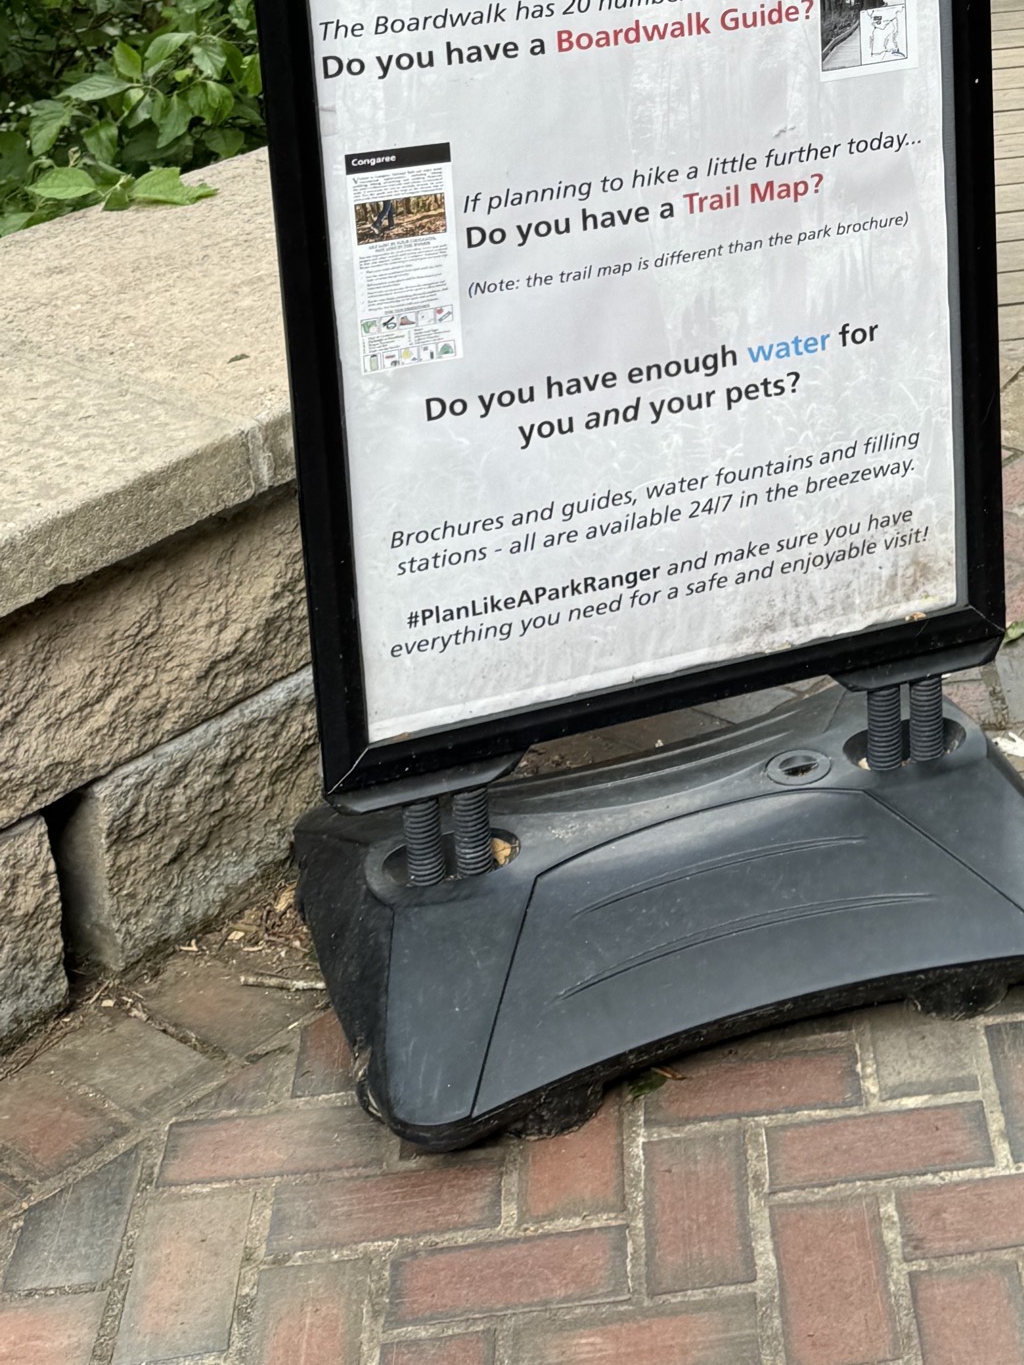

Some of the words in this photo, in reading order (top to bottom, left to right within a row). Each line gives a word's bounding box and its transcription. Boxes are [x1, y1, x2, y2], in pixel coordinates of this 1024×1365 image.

[319, 19, 364, 41] The
[374, 3, 506, 35] Boardwalk
[516, 1, 555, 20] has
[323, 56, 365, 79] Do
[376, 51, 434, 79] you
[446, 41, 519, 65] have
[530, 39, 545, 56] a
[557, 12, 711, 52] Boardwalk
[351, 155, 396, 166] Congaree
[464, 192, 482, 213] If
[487, 181, 591, 215] planning
[601, 176, 623, 192] to
[632, 166, 679, 188] hike
[687, 166, 698, 179] a
[707, 154, 757, 176] little
[765, 143, 841, 168] further
[847, 132, 921, 154] today...
[466, 226, 506, 248] Do
[516, 218, 570, 247] you
[582, 206, 649, 231] have
[660, 203, 674, 219] a
[683, 185, 739, 214] Trail
[751, 173, 823, 203] Map?
[469, 280, 519, 298] (Note:
[526, 273, 553, 287] the
[560, 265, 592, 283] trail
[597, 263, 632, 277] map
[638, 257, 649, 270] is
[654, 245, 723, 267] different
[729, 240, 762, 254] than
[769, 233, 792, 247] the
[798, 225, 831, 245] park
[837, 212, 908, 235] brochure)
[426, 397, 467, 421] Do
[478, 386, 534, 418] you
[547, 372, 617, 399] have
[628, 345, 737, 384] enough
[748, 334, 830, 363] water
[839, 323, 878, 347] for
[518, 417, 573, 449] you
[585, 397, 641, 430] and
[649, 390, 715, 424] your
[726, 372, 800, 410] pets?
[391, 516, 503, 549] Brochures
[512, 501, 554, 526] and
[562, 490, 637, 522] guides,
[647, 476, 708, 499] water
[715, 455, 813, 486] fountains
[820, 440, 857, 465] and
[864, 432, 919, 454] filling
[398, 547, 487, 575] stations
[510, 532, 536, 554] all
[543, 530, 578, 547] are
[586, 505, 681, 539] available
[689, 494, 733, 518] 24/7
[740, 491, 757, 508] in
[766, 483, 798, 502] the
[806, 459, 914, 494] breezeway.
[391, 622, 512, 657] everything
[520, 612, 560, 637] you
[569, 594, 622, 622] need
[630, 590, 661, 608] for
[668, 587, 678, 599] a
[686, 573, 728, 596] safe
[735, 560, 774, 585] and
[781, 536, 877, 574] enjoyable
[885, 526, 928, 550] visit!
[407, 566, 660, 628] #PlanLikeAParkRanger
[667, 551, 707, 575] and
[714, 541, 769, 566] make
[777, 532, 818, 552] sure
[824, 522, 860, 546] you
[868, 510, 912, 531] have
